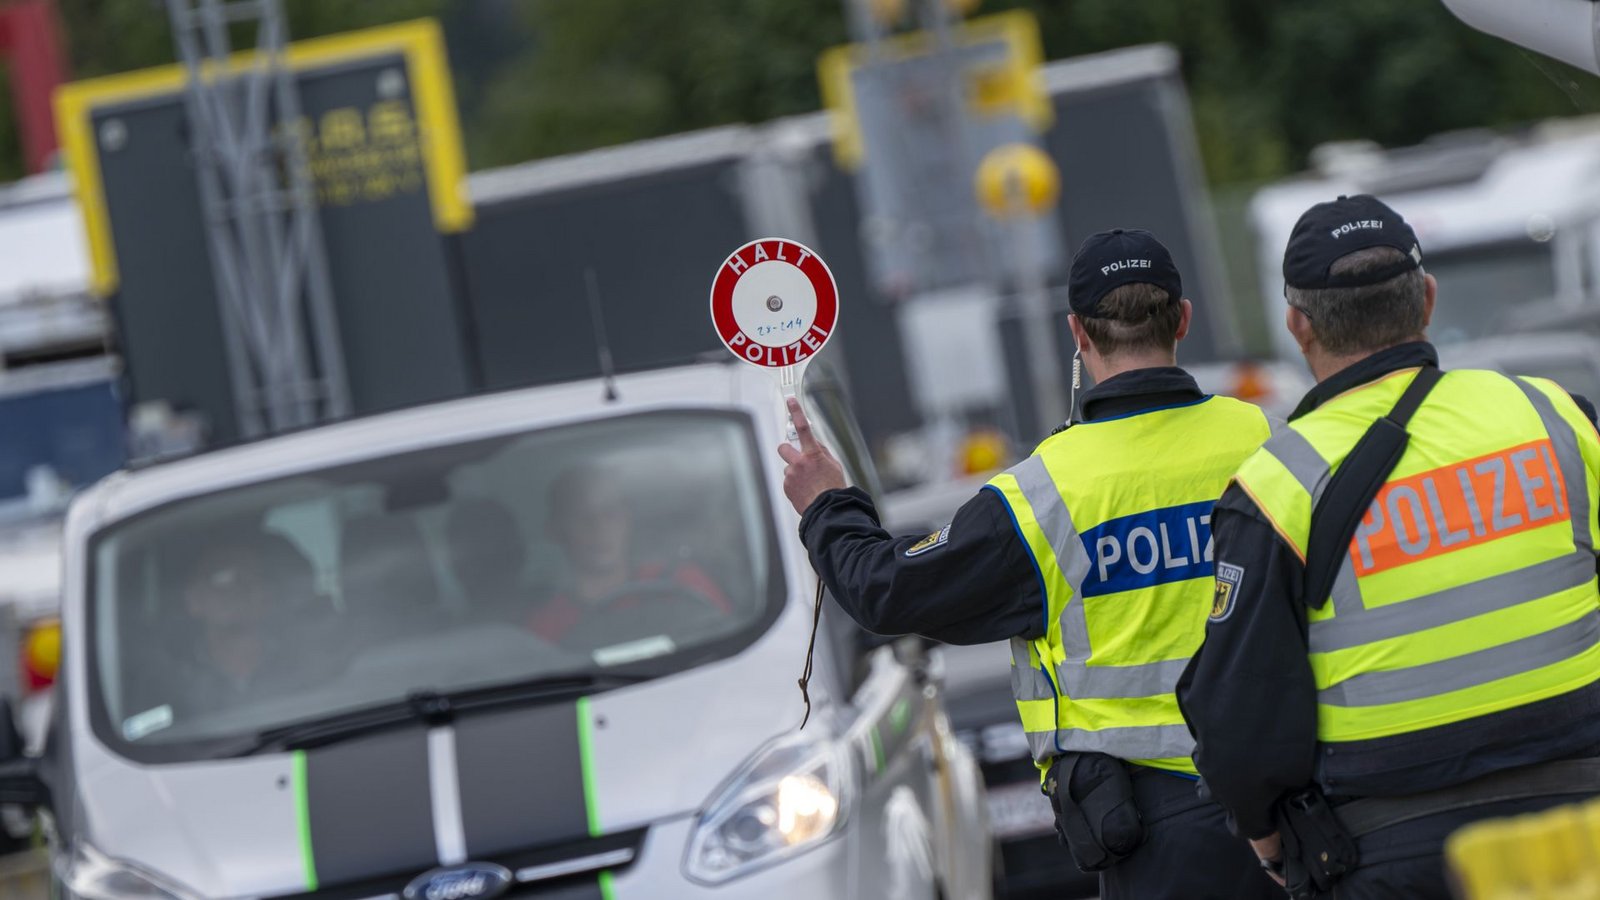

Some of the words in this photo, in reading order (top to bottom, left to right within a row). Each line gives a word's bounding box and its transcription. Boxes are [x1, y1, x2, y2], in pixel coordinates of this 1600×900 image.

[1331, 220, 1383, 239] POLIZEI
[727, 242, 811, 275] HALT
[1100, 259, 1151, 276] POLIZEI
[729, 325, 828, 366] POLIZEI
[1354, 445, 1564, 570] POLIZEI
[1096, 514, 1214, 582] POLIZ
